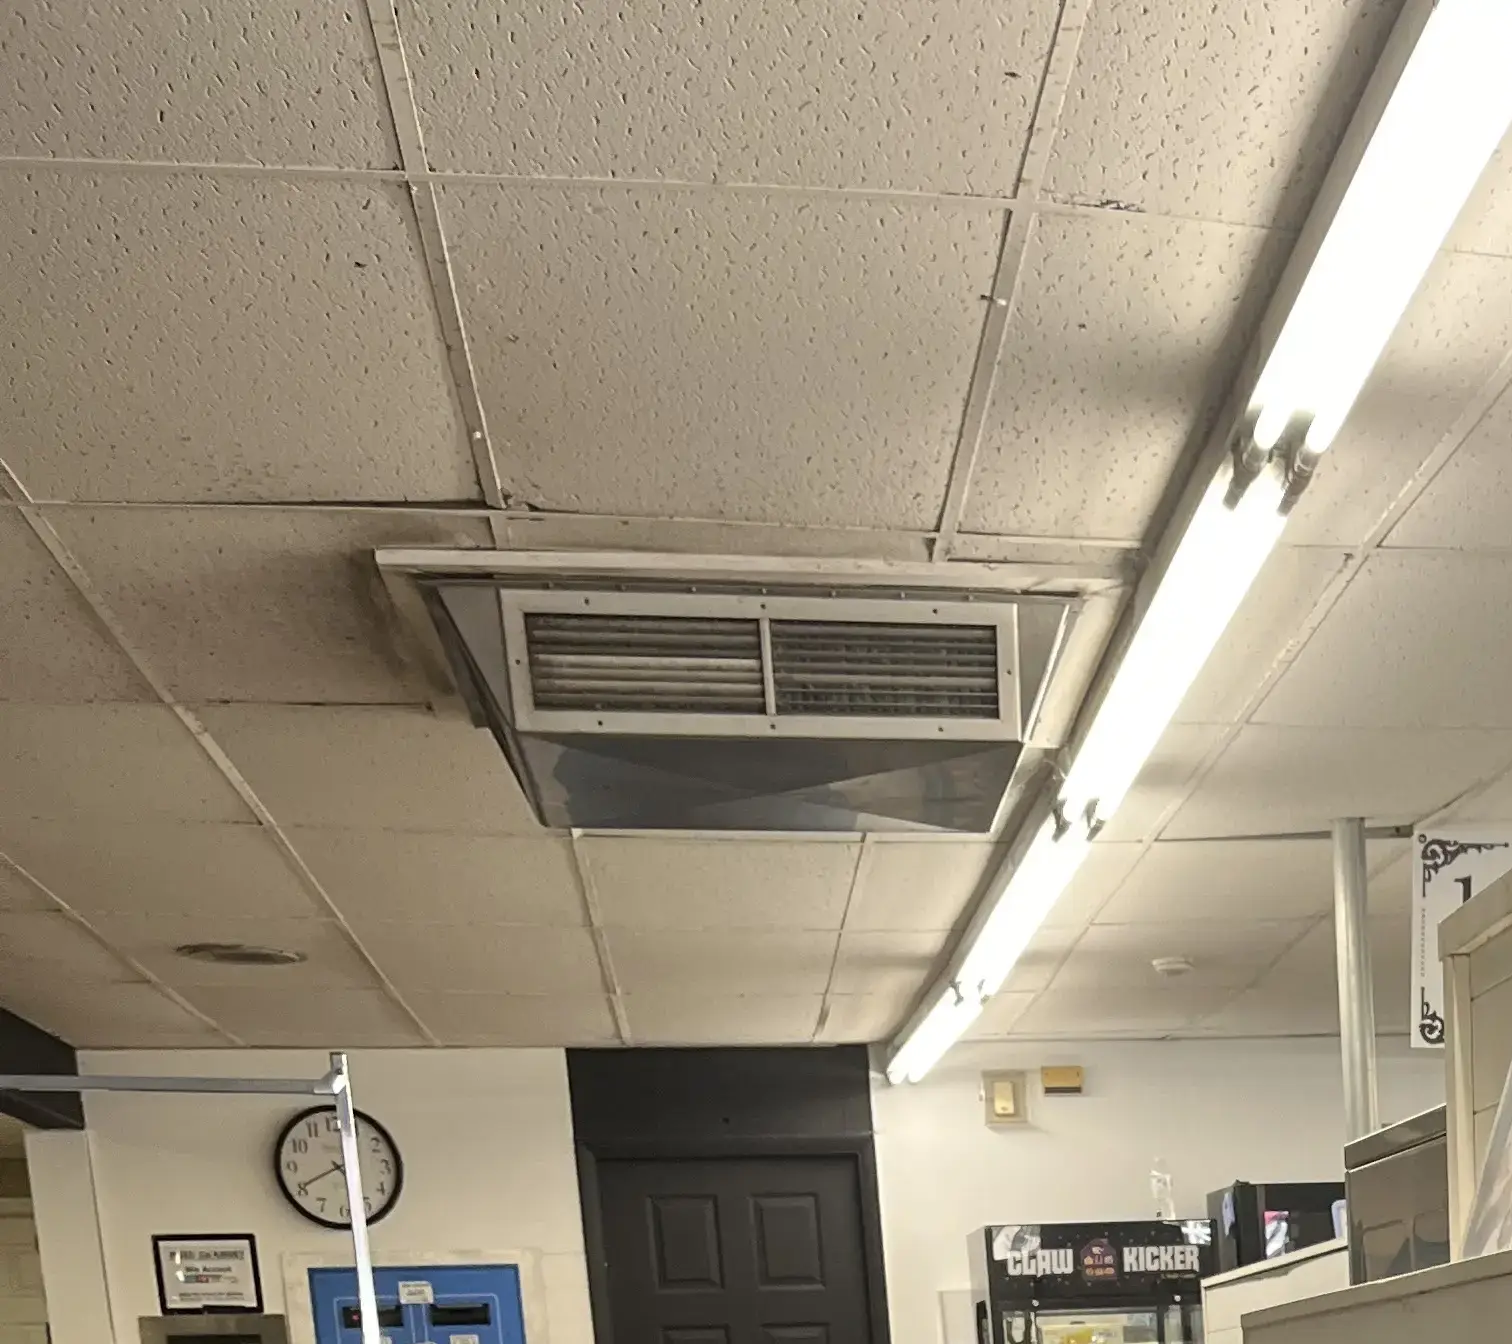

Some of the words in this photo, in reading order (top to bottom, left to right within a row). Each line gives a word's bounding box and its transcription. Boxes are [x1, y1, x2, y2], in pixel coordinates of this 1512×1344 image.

[307, 1122, 319, 1138] 11
[292, 1138, 308, 1154] 10
[371, 1137, 381, 1153] 2
[286, 1160, 298, 1174] 9
[380, 1159, 391, 1175] 3
[298, 1182, 308, 1197] 8
[375, 1182, 385, 1196] 4
[315, 1197, 327, 1213] 7
[1007, 1249, 1074, 1277] CLAW
[1123, 1245, 1200, 1272] KICKER
